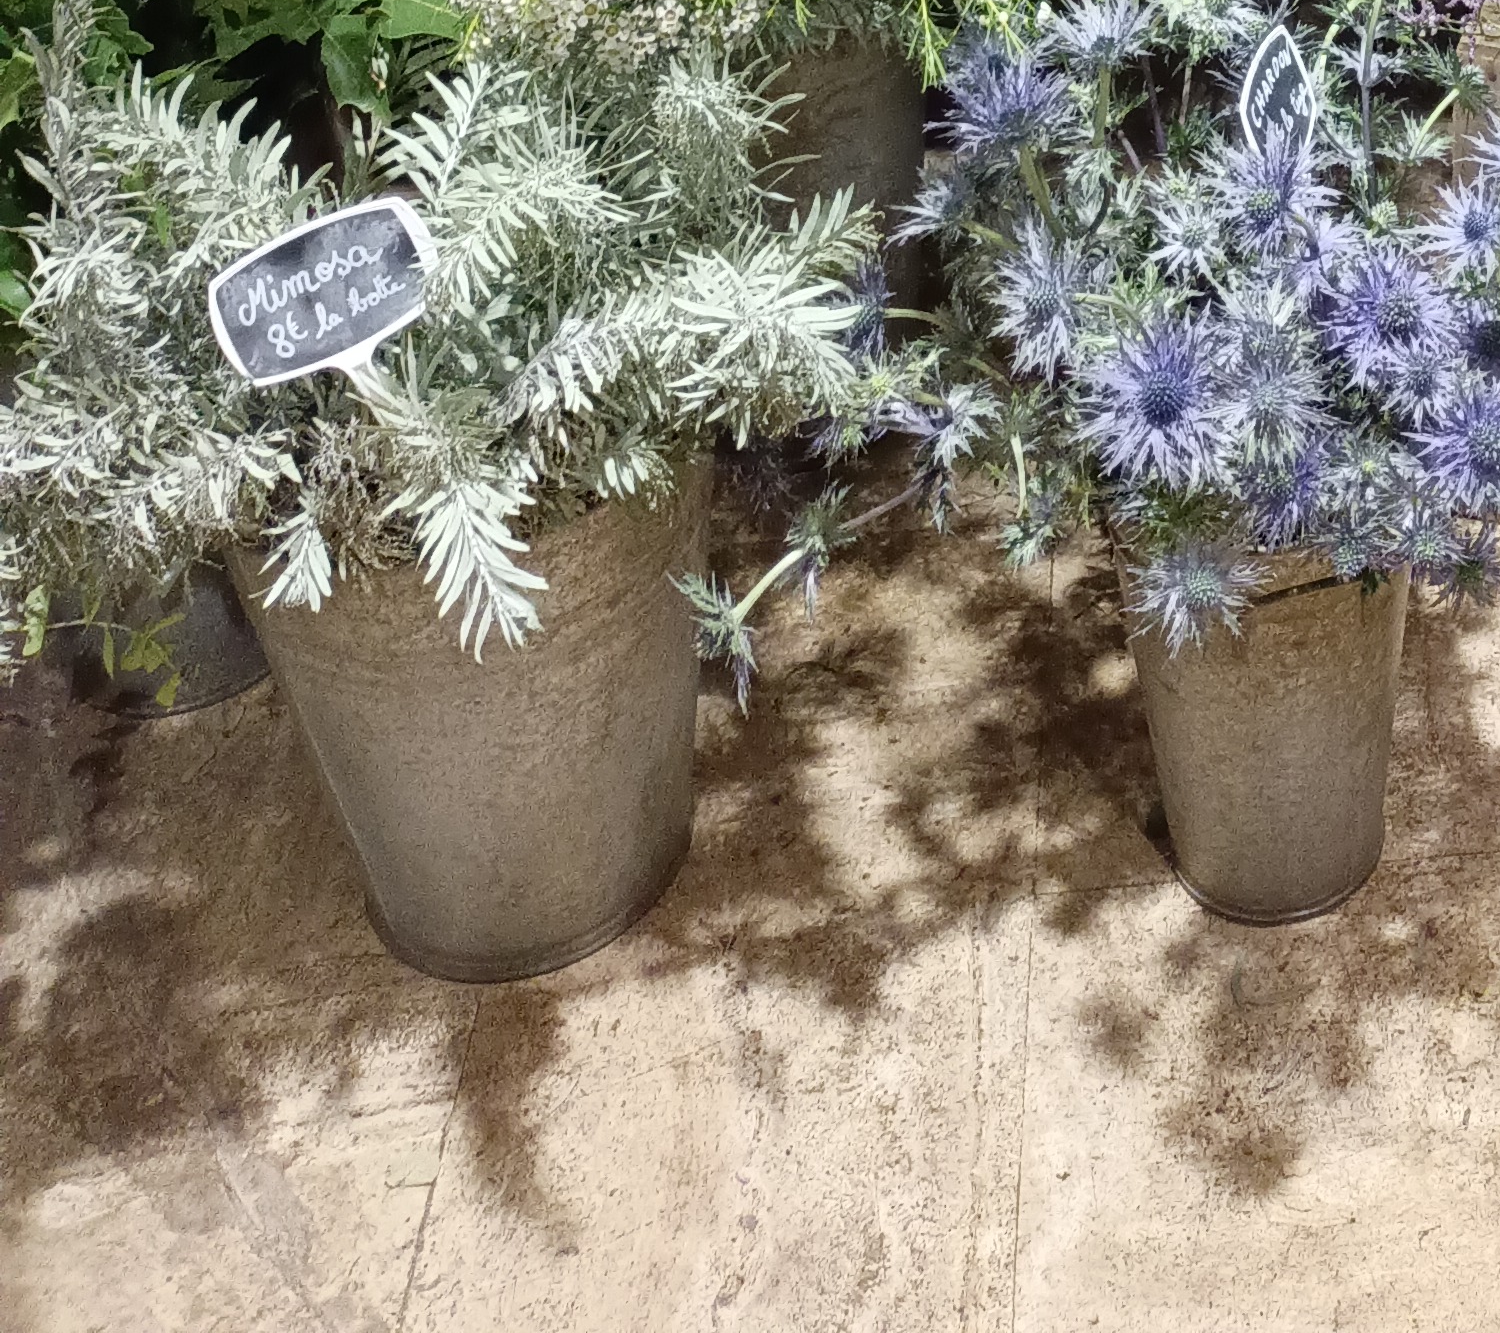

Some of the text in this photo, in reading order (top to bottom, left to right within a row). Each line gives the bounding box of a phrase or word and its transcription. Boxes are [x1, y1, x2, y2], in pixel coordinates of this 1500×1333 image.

[238, 244, 383, 327] Mimosa
[267, 274, 406, 359] 8€ la botte
